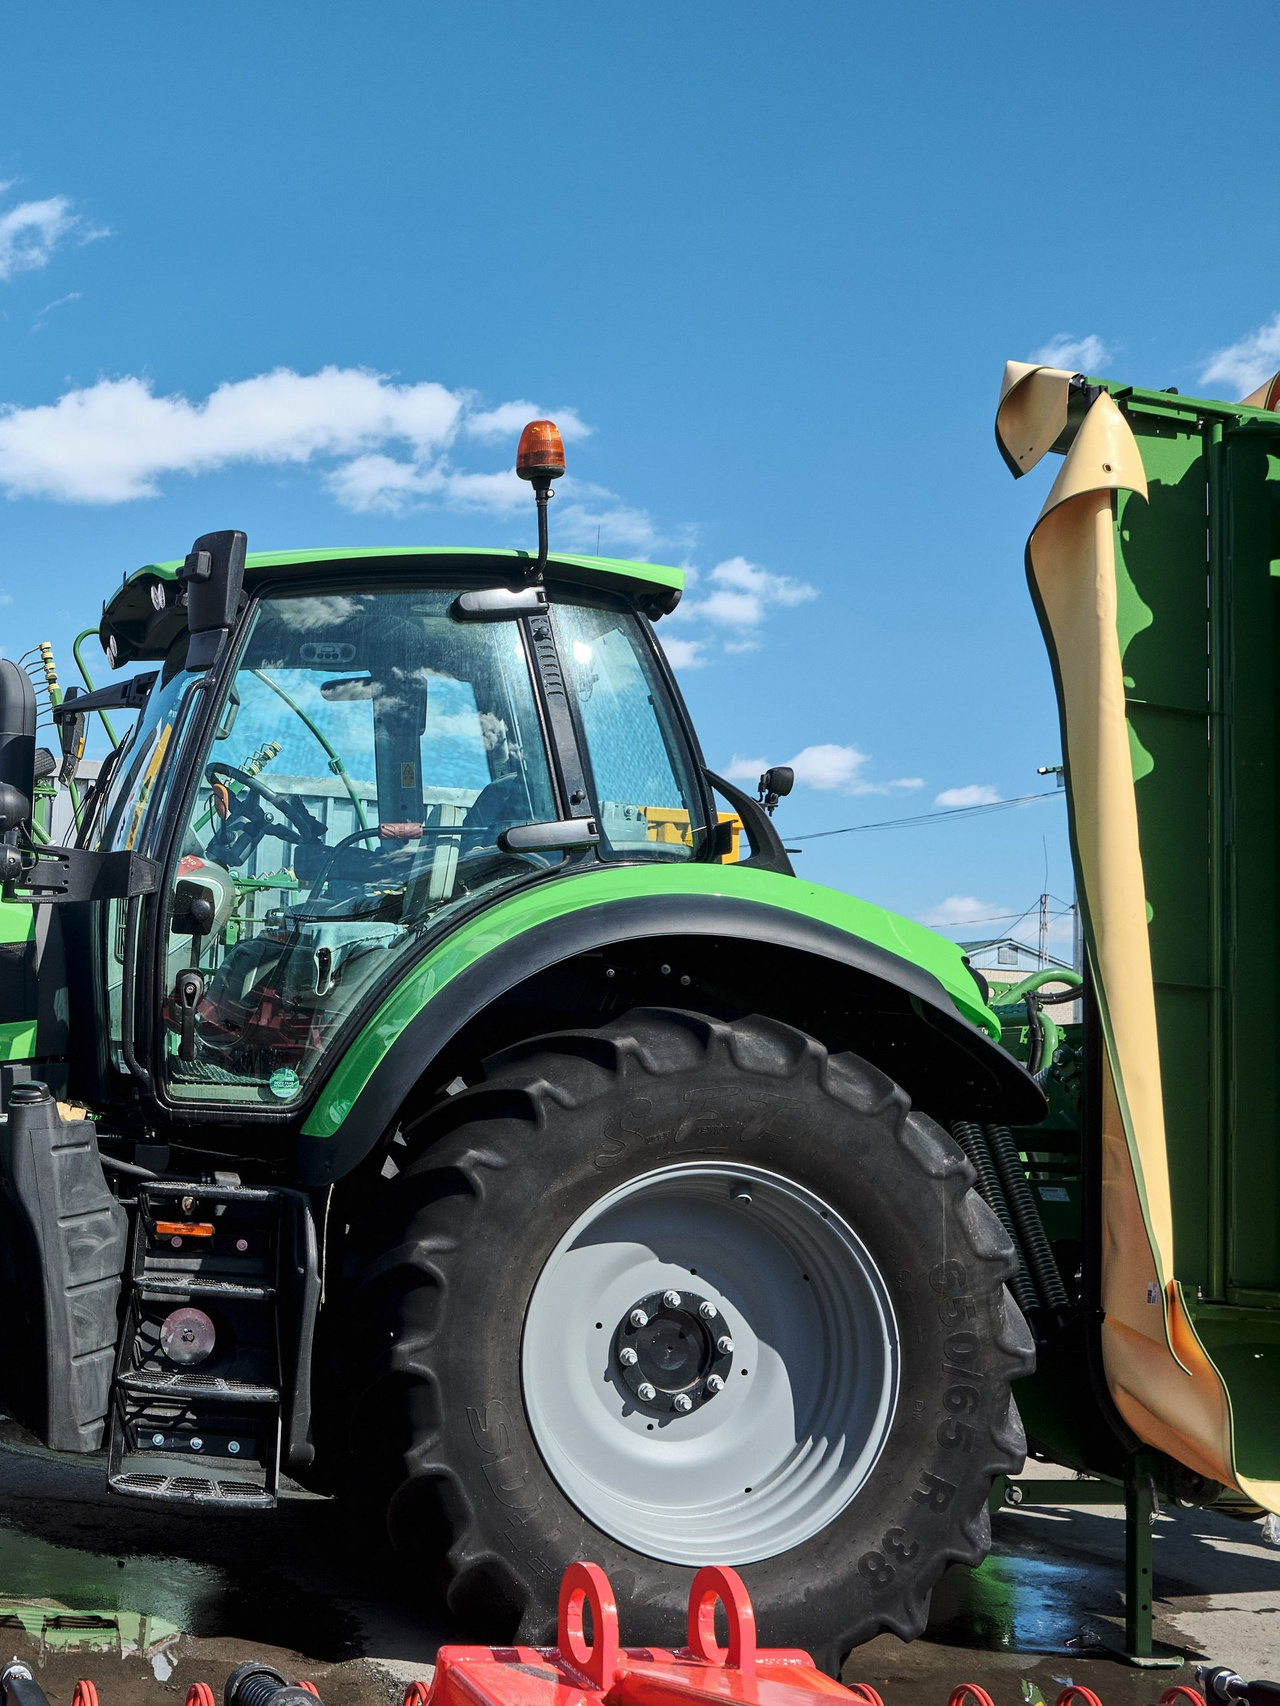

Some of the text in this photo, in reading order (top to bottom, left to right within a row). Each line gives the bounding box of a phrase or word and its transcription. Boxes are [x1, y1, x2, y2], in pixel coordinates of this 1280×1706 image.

[857, 1257, 984, 1591] 650/65 R 38
